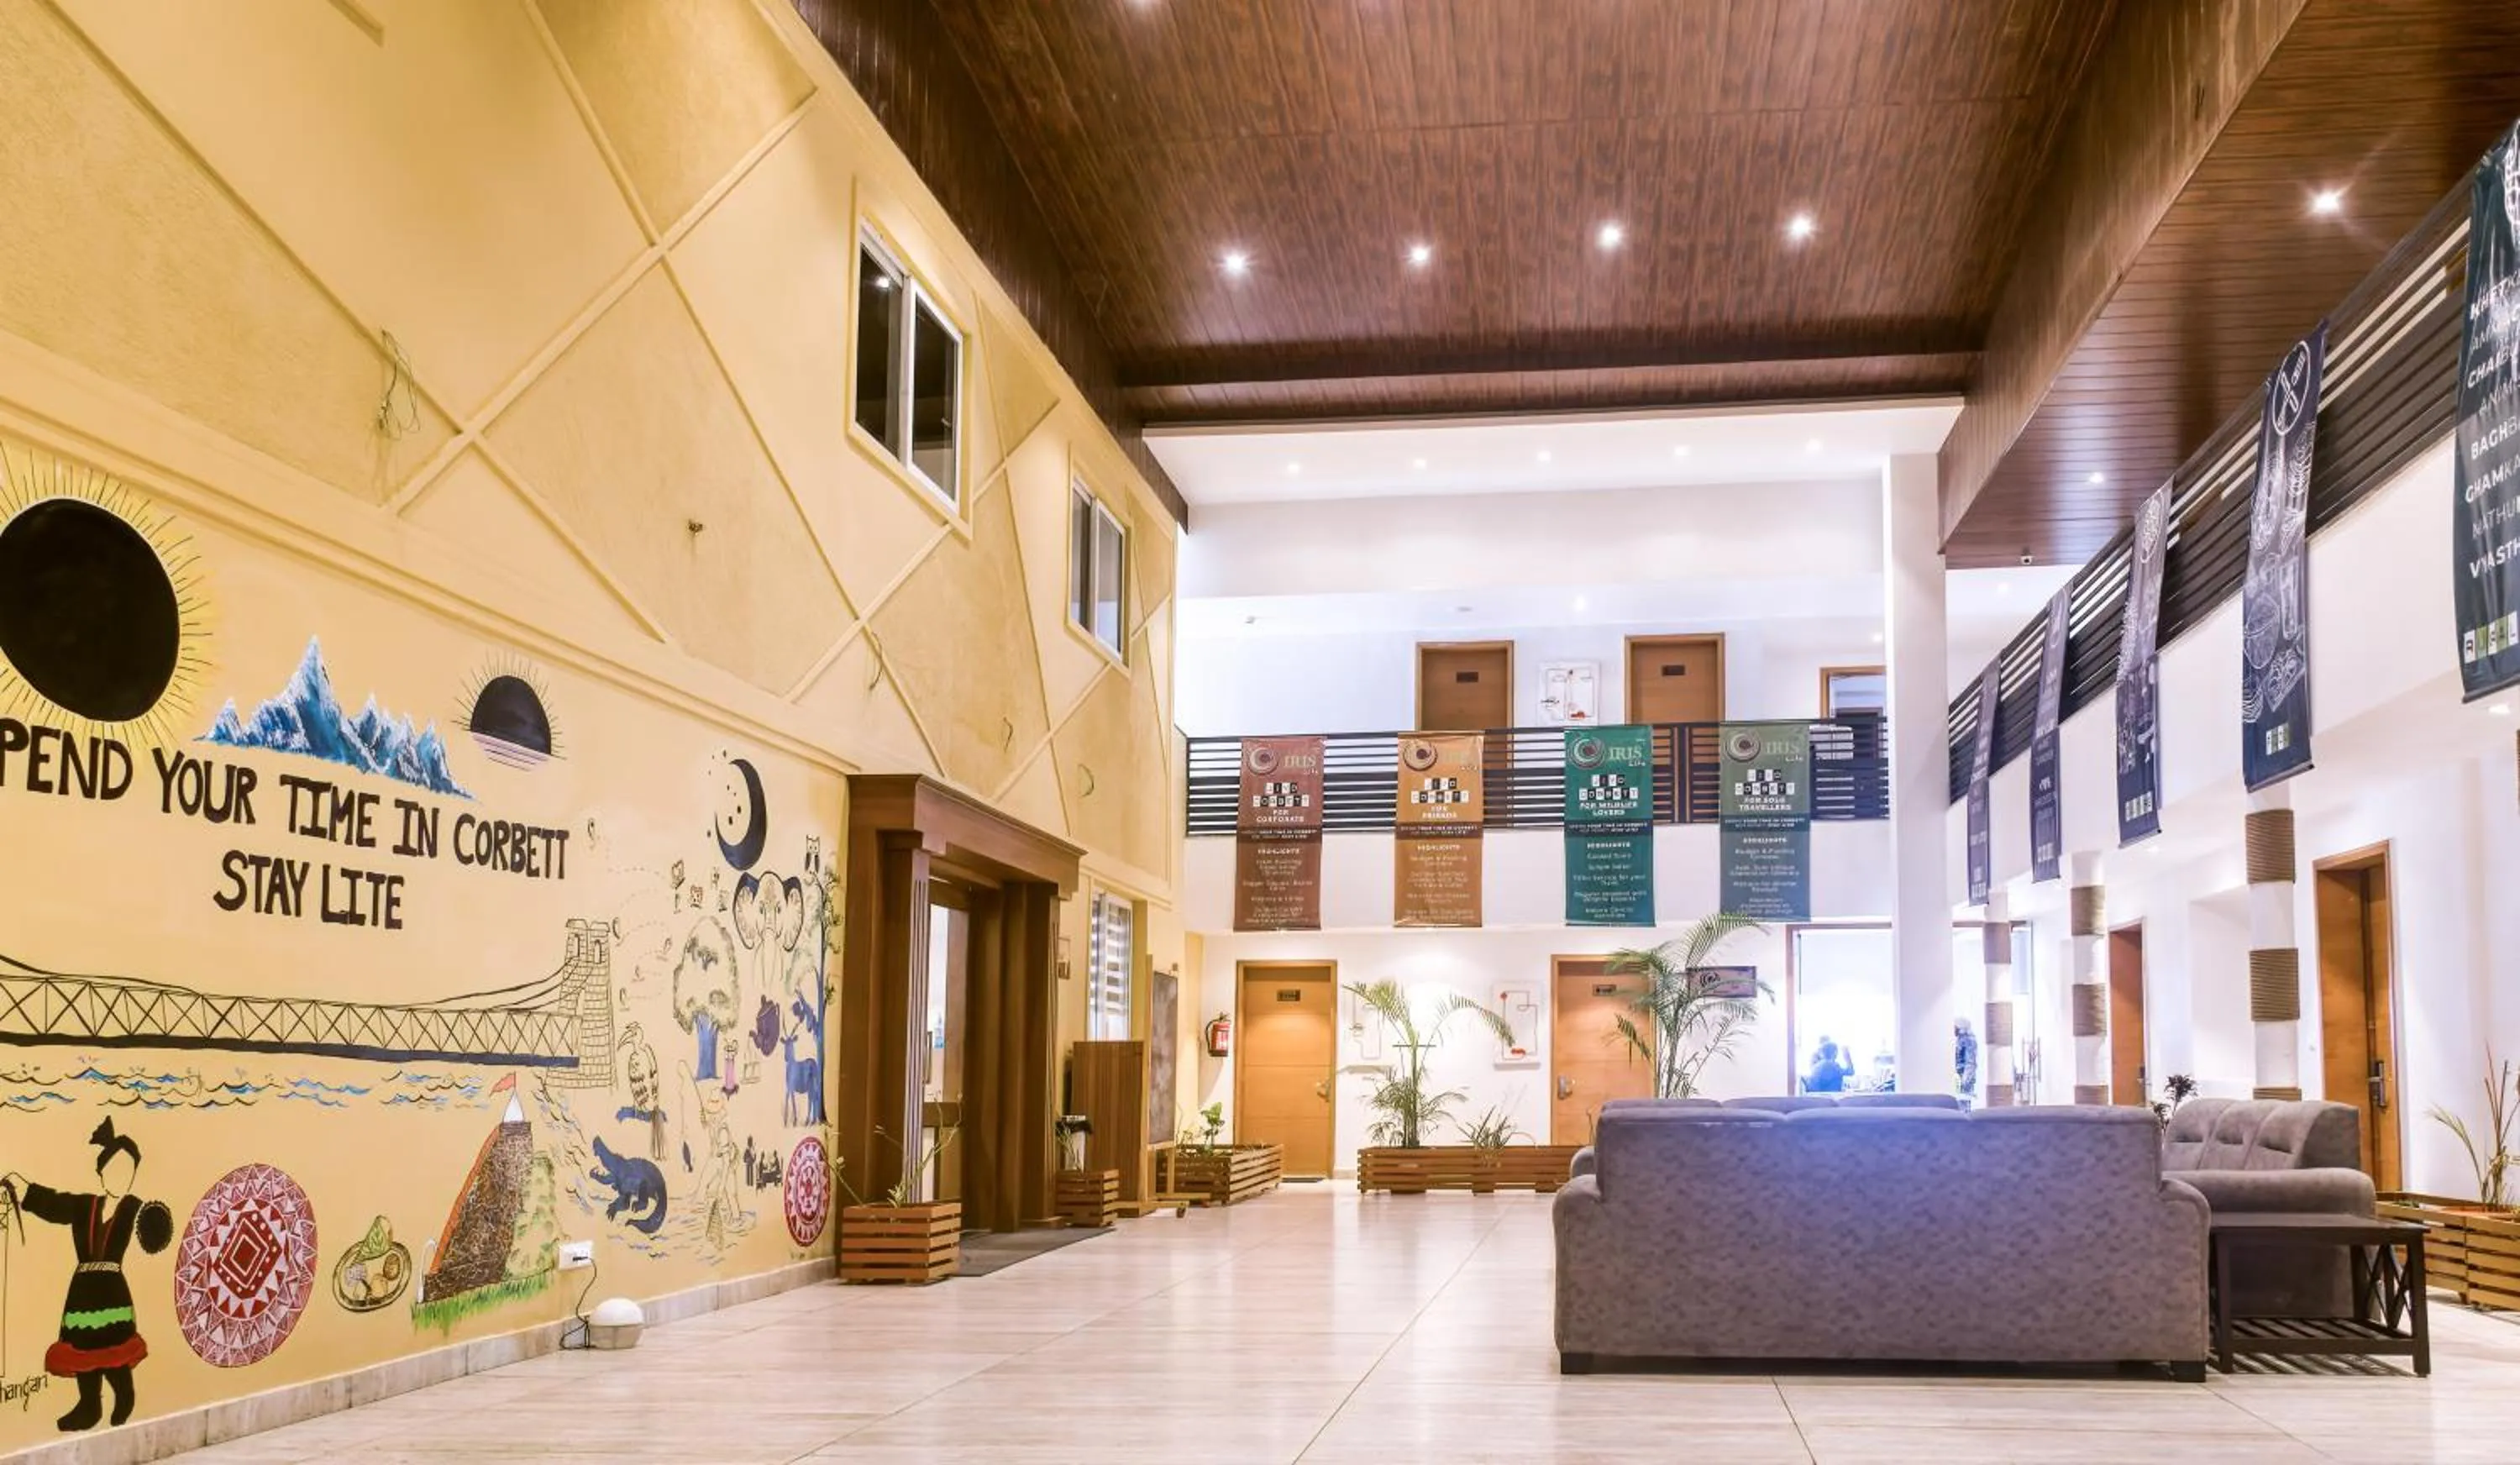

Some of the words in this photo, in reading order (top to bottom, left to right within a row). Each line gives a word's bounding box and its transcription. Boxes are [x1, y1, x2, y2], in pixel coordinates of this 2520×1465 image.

[2470, 416, 2520, 460] BAGHB
[1608, 745, 1643, 760] IRIS
[0, 718, 133, 801] PEND
[152, 748, 257, 824] YOUR
[281, 774, 380, 848] TIME
[393, 799, 439, 858] IN
[454, 813, 570, 880] CORBETT
[213, 850, 309, 917] STAY
[321, 864, 404, 929] LITE
